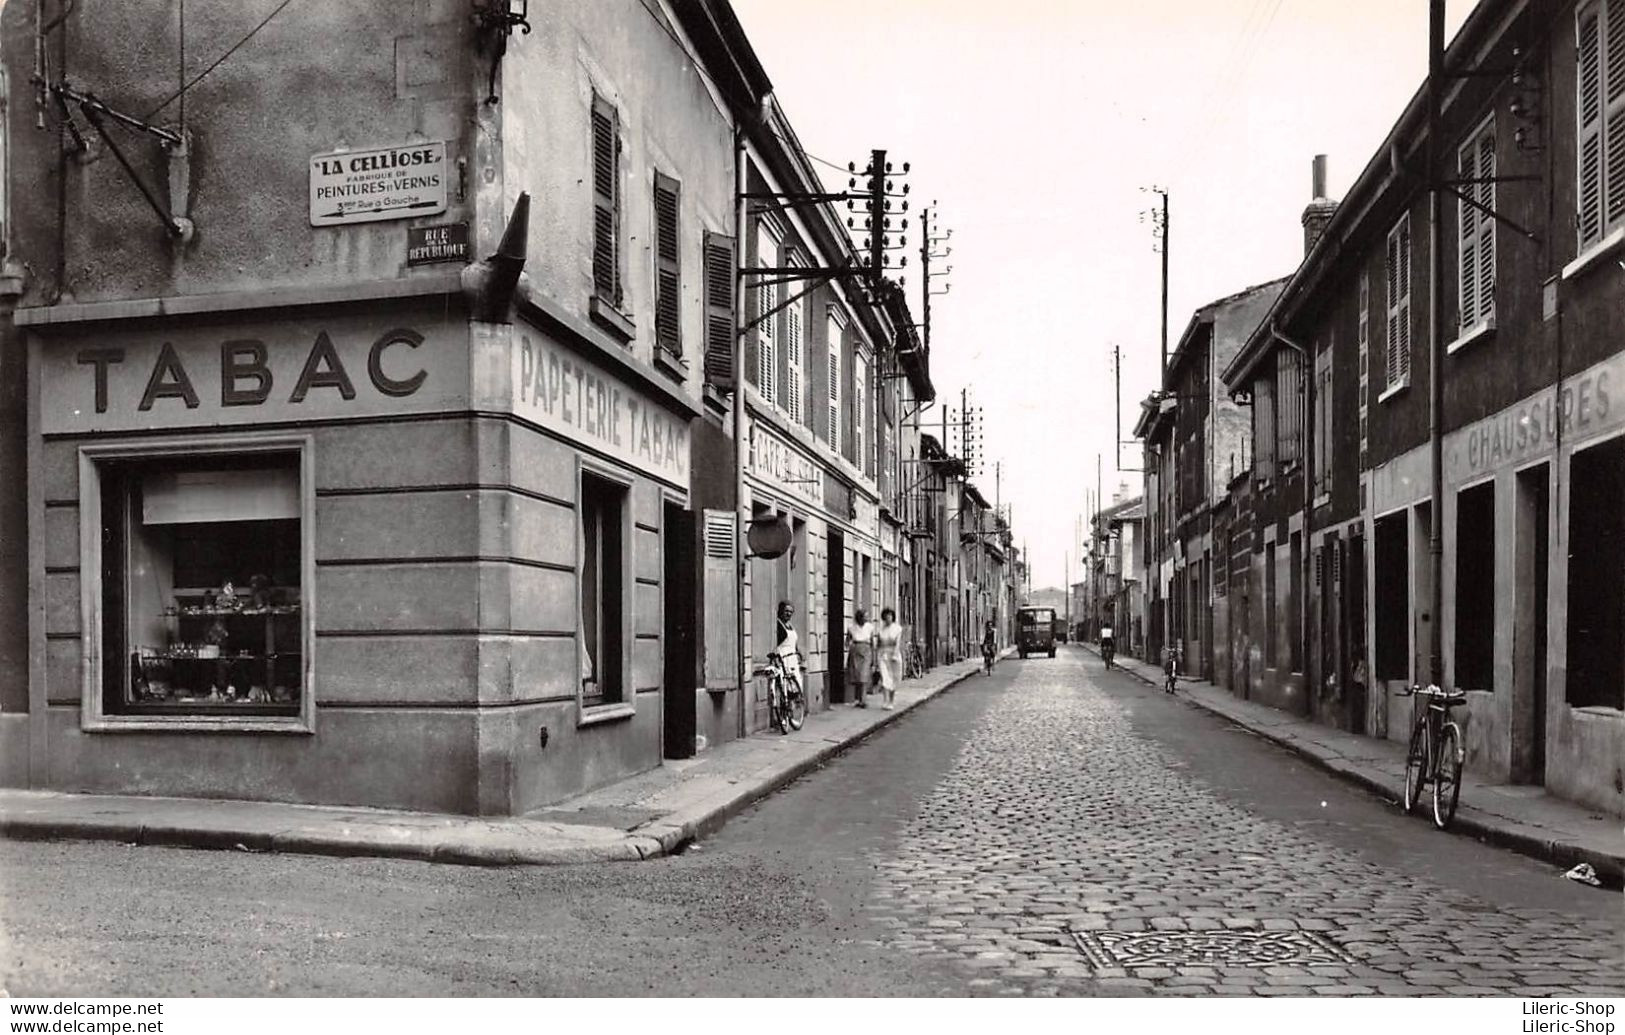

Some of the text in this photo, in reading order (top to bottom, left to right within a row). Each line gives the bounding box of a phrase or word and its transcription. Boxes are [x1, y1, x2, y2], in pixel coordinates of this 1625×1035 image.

[317, 181, 386, 199] PEINTURES
[394, 174, 440, 191] VERNIS
[346, 171, 393, 183] FABRIQUE
[358, 200, 373, 209] Rue
[383, 196, 420, 206] Gauche
[425, 228, 448, 241] RUE
[76, 327, 429, 413] TABAC
[521, 335, 686, 476] PAPETERIE TABAC
[1468, 370, 1611, 470] CHAUSSURES
